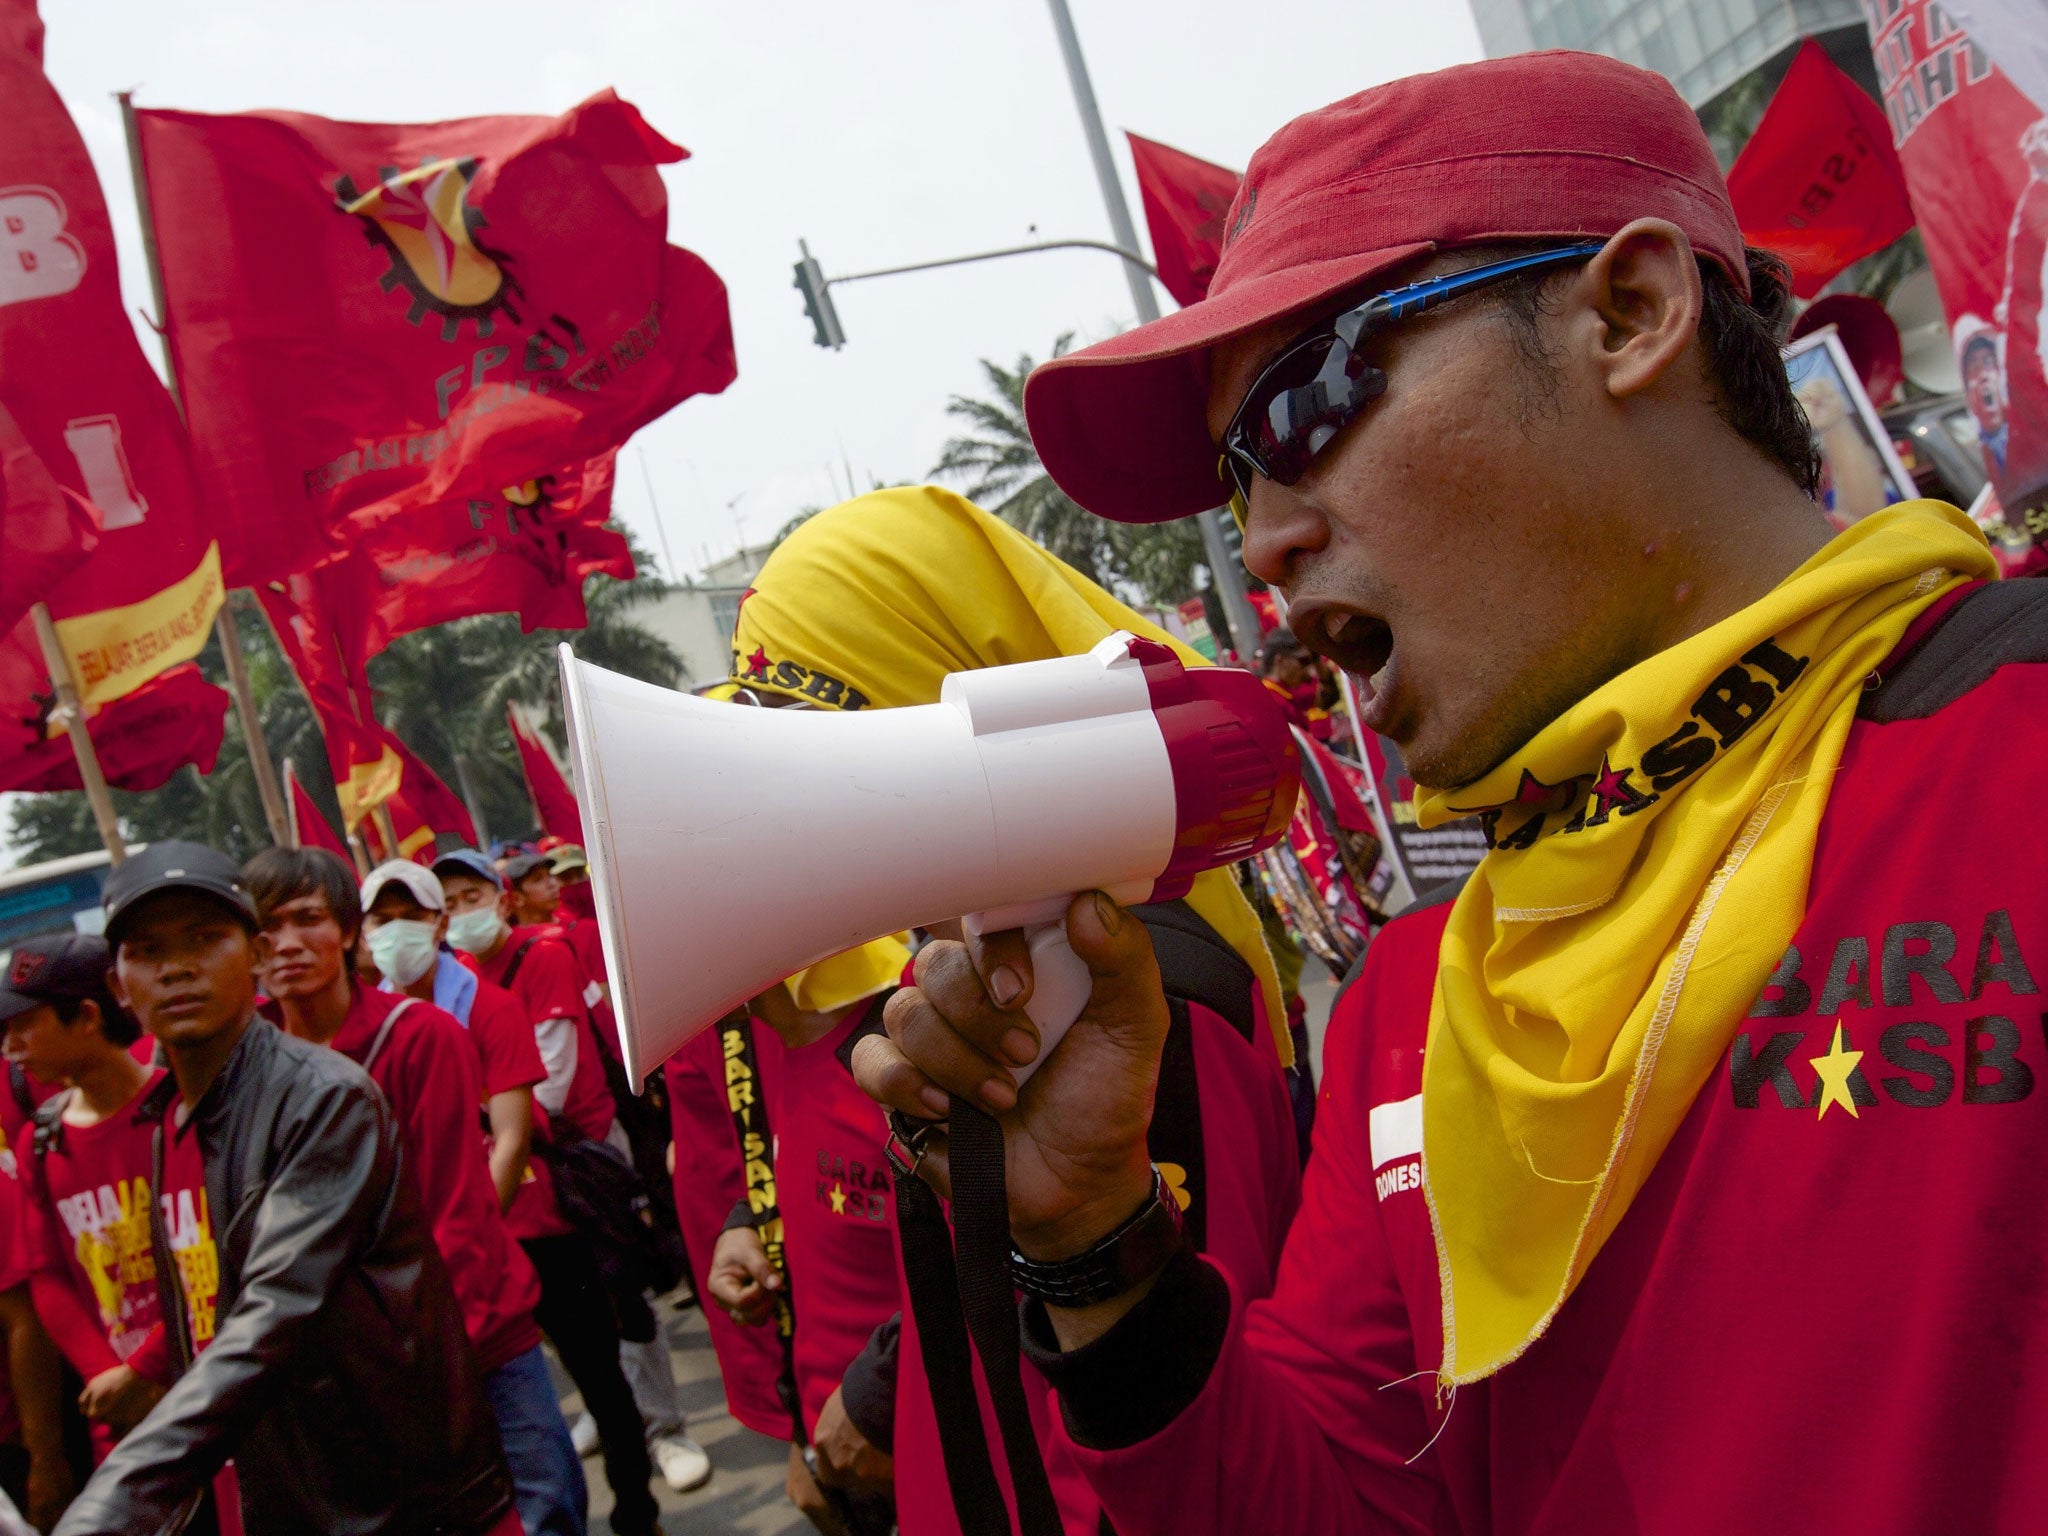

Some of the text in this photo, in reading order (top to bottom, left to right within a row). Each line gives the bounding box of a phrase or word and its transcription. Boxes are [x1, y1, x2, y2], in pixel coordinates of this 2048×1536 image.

[1747, 908, 2041, 1018] BARA
[722, 1029, 777, 1215] BARISAN
[817, 1149, 891, 1194] BARA
